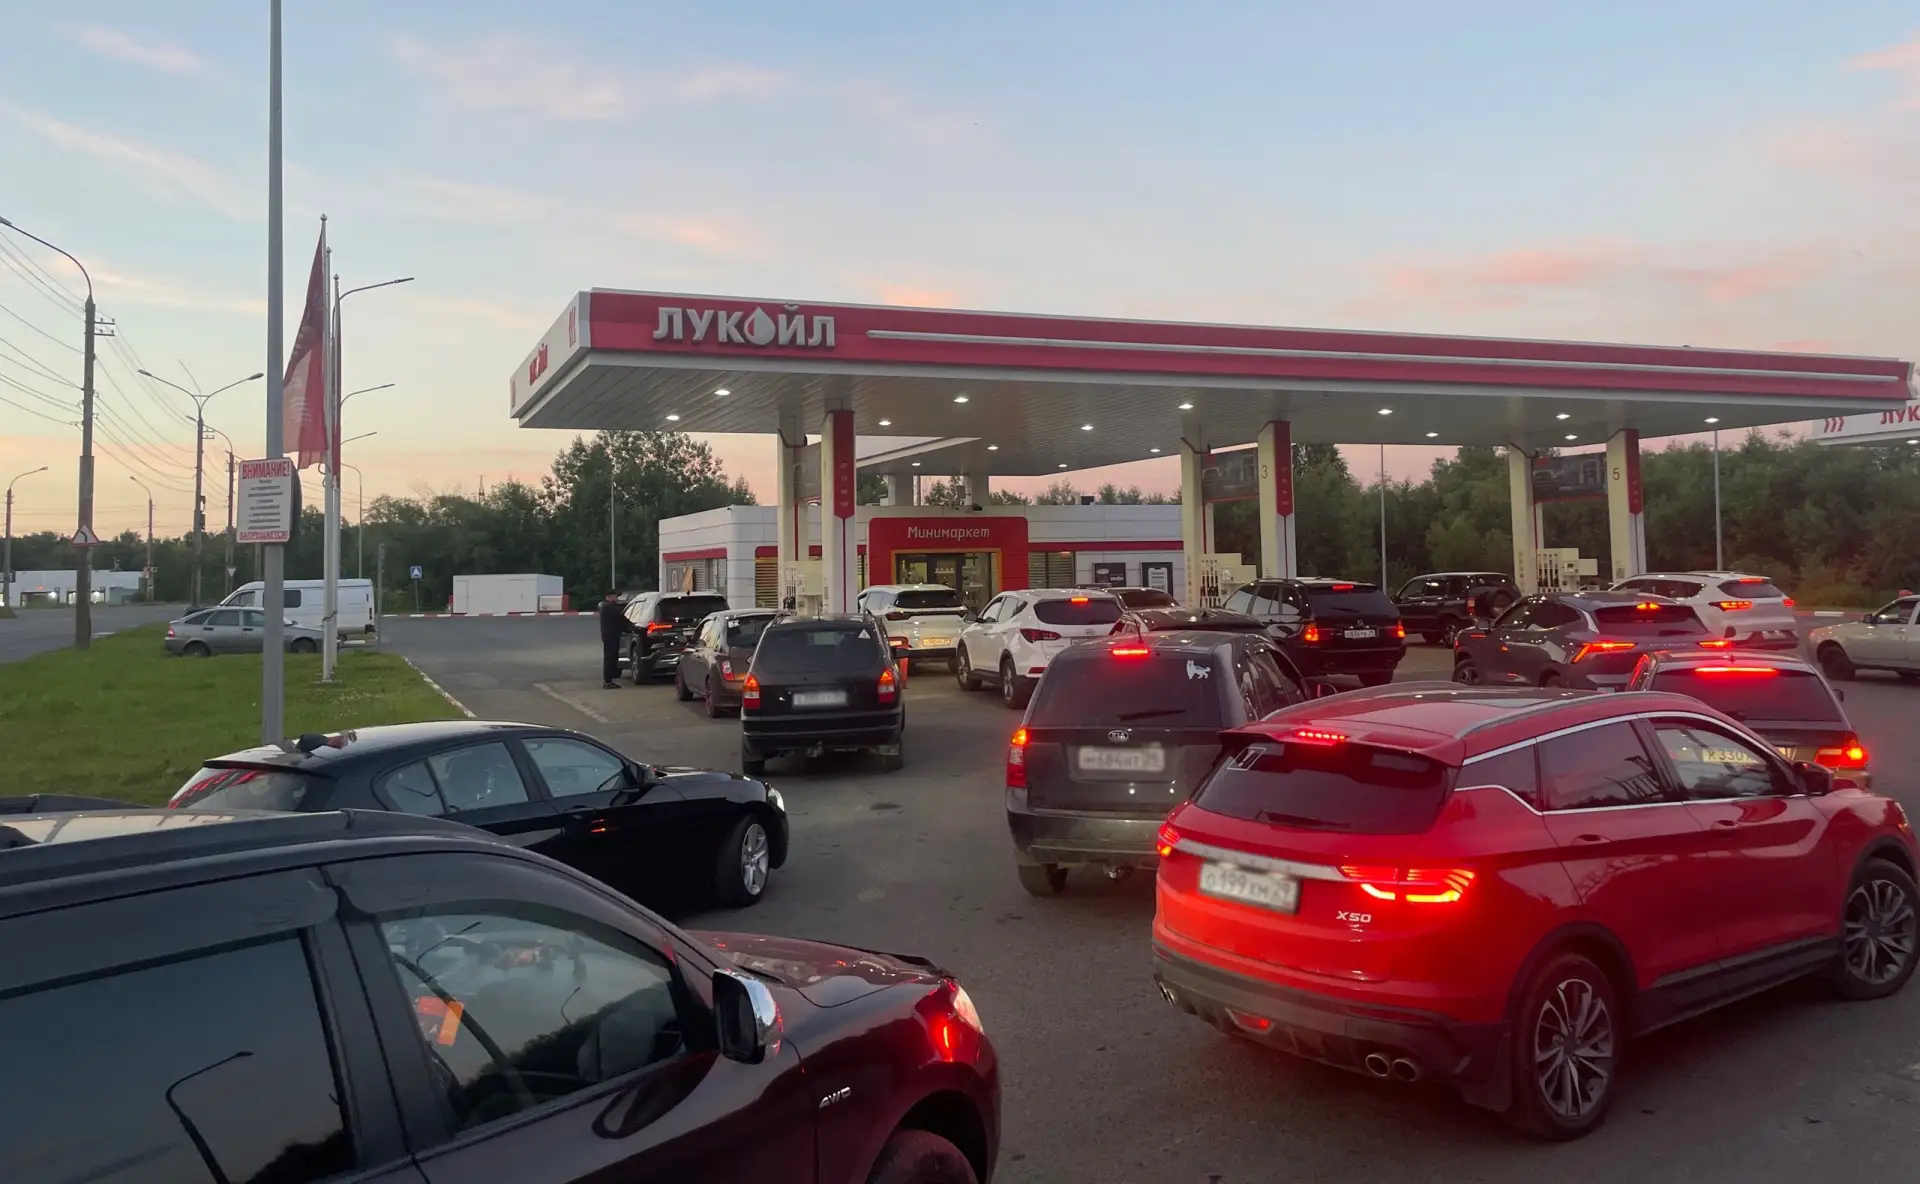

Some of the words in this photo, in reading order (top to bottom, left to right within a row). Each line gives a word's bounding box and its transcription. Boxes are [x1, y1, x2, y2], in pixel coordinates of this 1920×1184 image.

[653, 303, 836, 347] ЛУКОЙЛ
[242, 460, 290, 479] ВНИМАНИЕ!
[1261, 464, 1268, 479] 3
[1612, 467, 1620, 481] 5
[908, 526, 989, 541] Минимаркет
[1336, 910, 1372, 923] X50
[819, 1086, 851, 1109] 4WD
